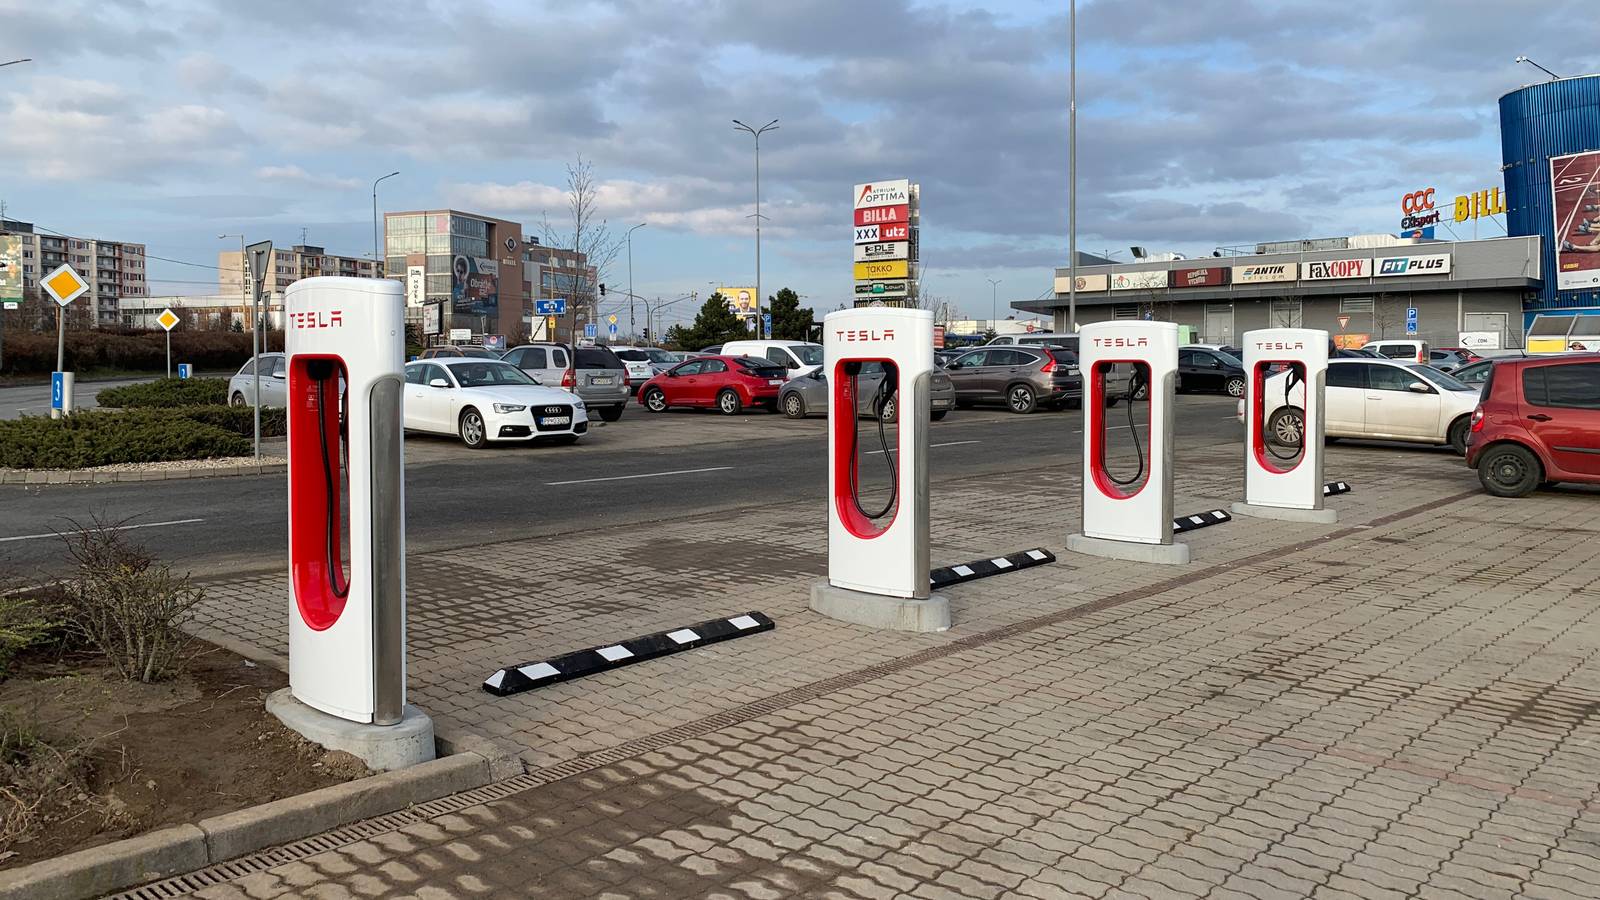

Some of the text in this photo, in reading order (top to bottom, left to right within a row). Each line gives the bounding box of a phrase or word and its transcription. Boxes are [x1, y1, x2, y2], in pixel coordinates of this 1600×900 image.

[865, 192, 905, 202] OPTIMA
[1401, 187, 1435, 215] CCC
[863, 207, 897, 223] BILLA
[856, 226, 905, 240] XXX Lutz
[1253, 265, 1285, 275] ANTIK
[1383, 259, 1444, 272] FIT PLUS
[290, 311, 342, 329] TESLA
[1408, 309, 1416, 318] P
[836, 329, 894, 342] TESLA
[1093, 337, 1147, 347] TESLA
[1256, 342, 1303, 350] TESLA
[55, 380, 61, 401] 3
